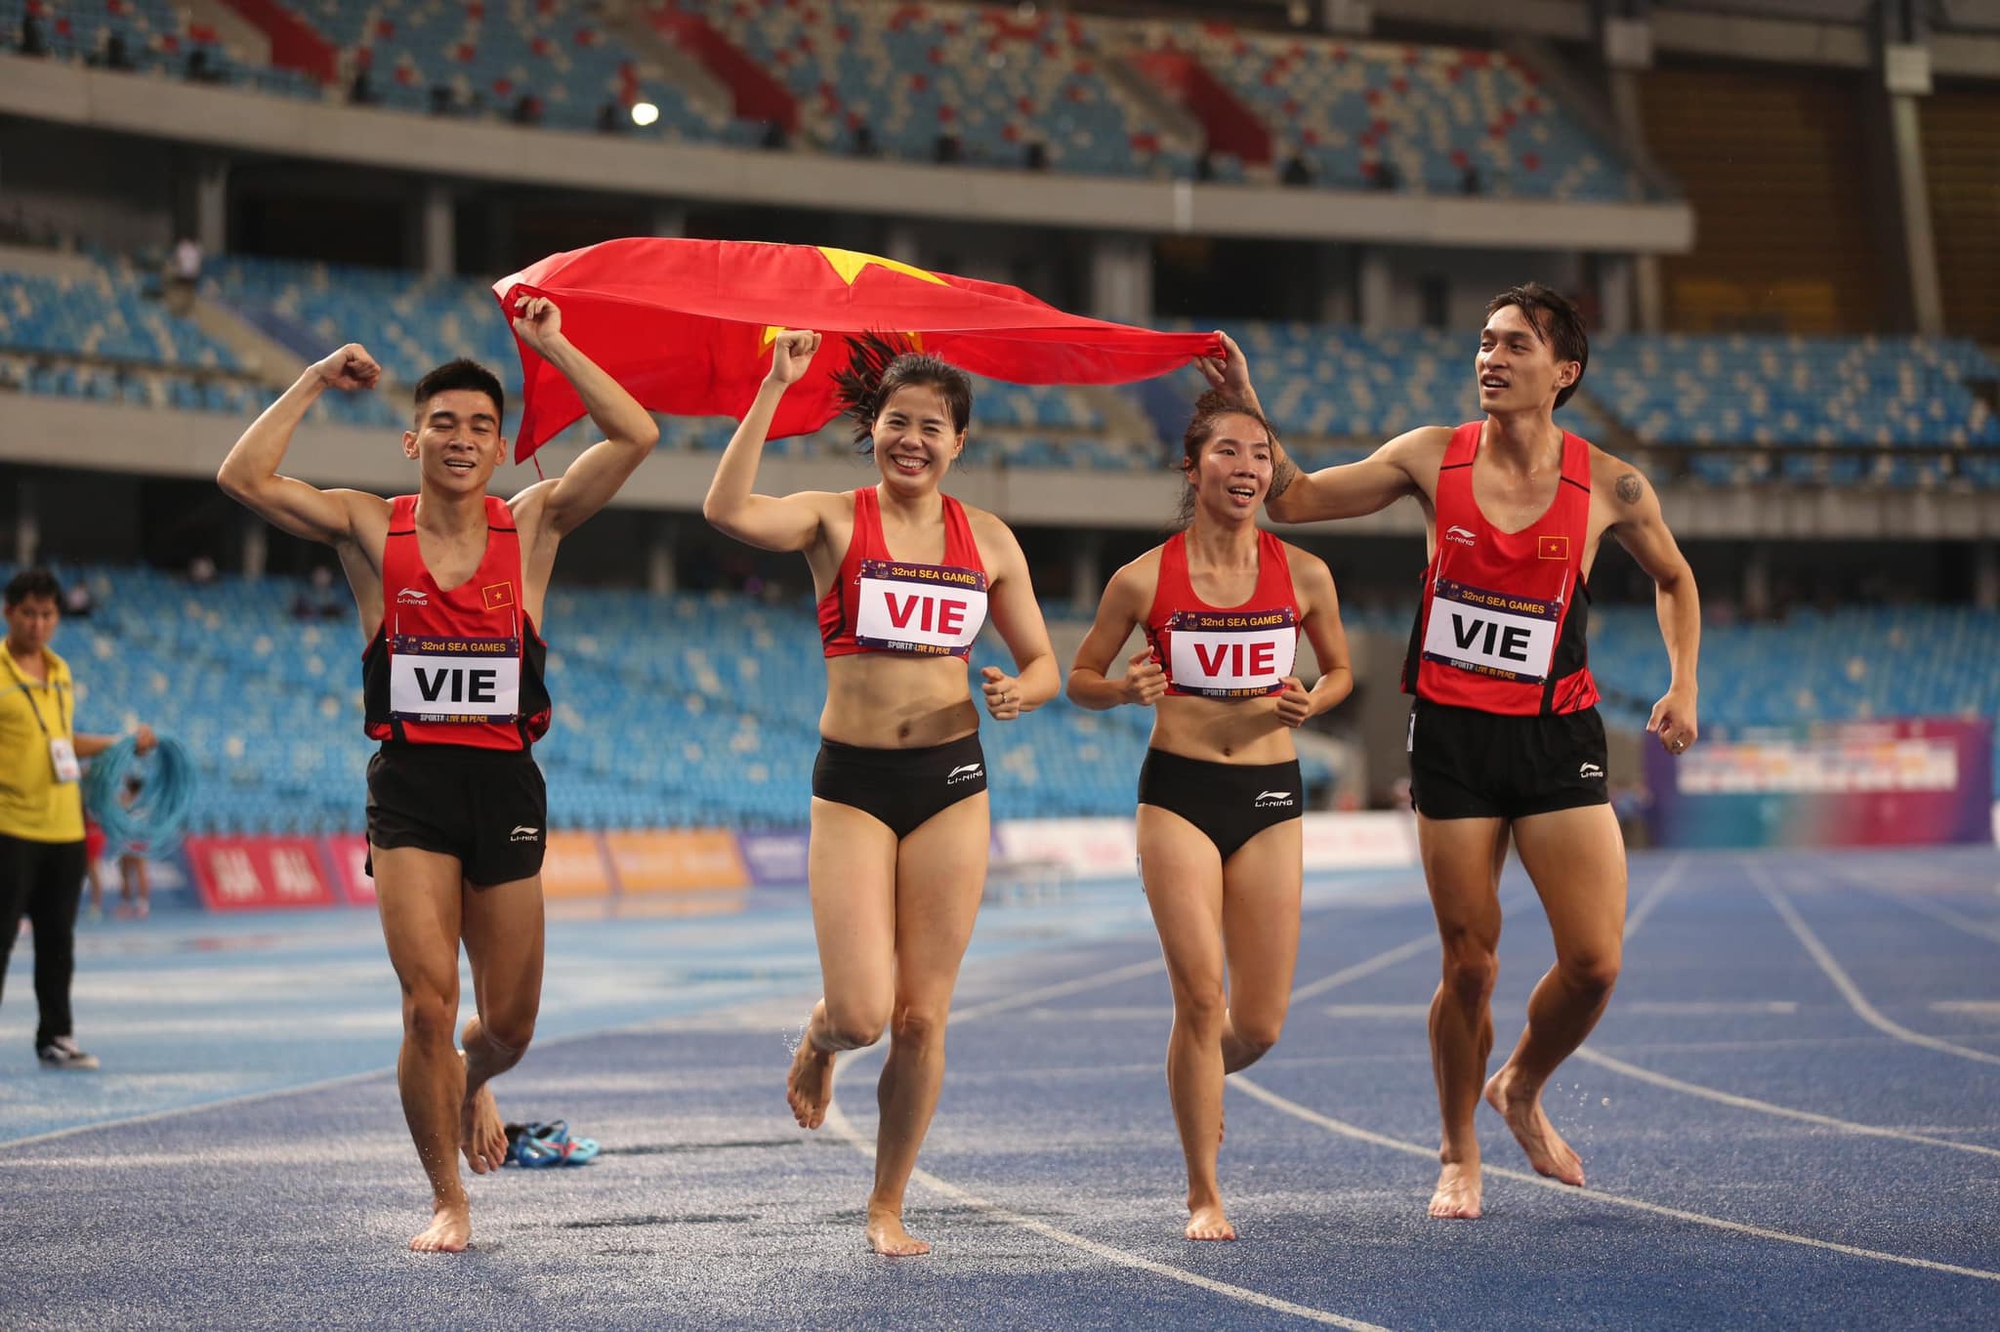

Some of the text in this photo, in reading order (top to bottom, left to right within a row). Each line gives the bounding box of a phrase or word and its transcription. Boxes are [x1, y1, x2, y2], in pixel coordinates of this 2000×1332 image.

[891, 567, 976, 585] 32nd SEA GAMES
[1461, 590, 1545, 614] 32nd SEA GAMES
[884, 592, 967, 635] VIE
[1200, 614, 1283, 626] 32nd SEA GAMES
[1452, 613, 1532, 662] VIE
[421, 641, 506, 652] 32nd SEA GAMES
[914, 643, 927, 653] LIVE
[928, 645, 935, 654] IN
[935, 646, 951, 655] PEACE
[1193, 641, 1275, 677] VIE
[1474, 664, 1488, 674] LIVE
[1489, 667, 1496, 676] IN
[1496, 669, 1517, 680] PEACE
[414, 667, 497, 703] VIE
[1228, 688, 1241, 697] LIVE
[1242, 688, 1250, 696] IN
[1251, 687, 1268, 695] PEACE
[446, 714, 460, 722] LIVE
[461, 714, 468, 722] IN
[469, 715, 488, 723] PEACE
[947, 769, 984, 785] LI-NING
[1254, 799, 1293, 807] LI-NING
